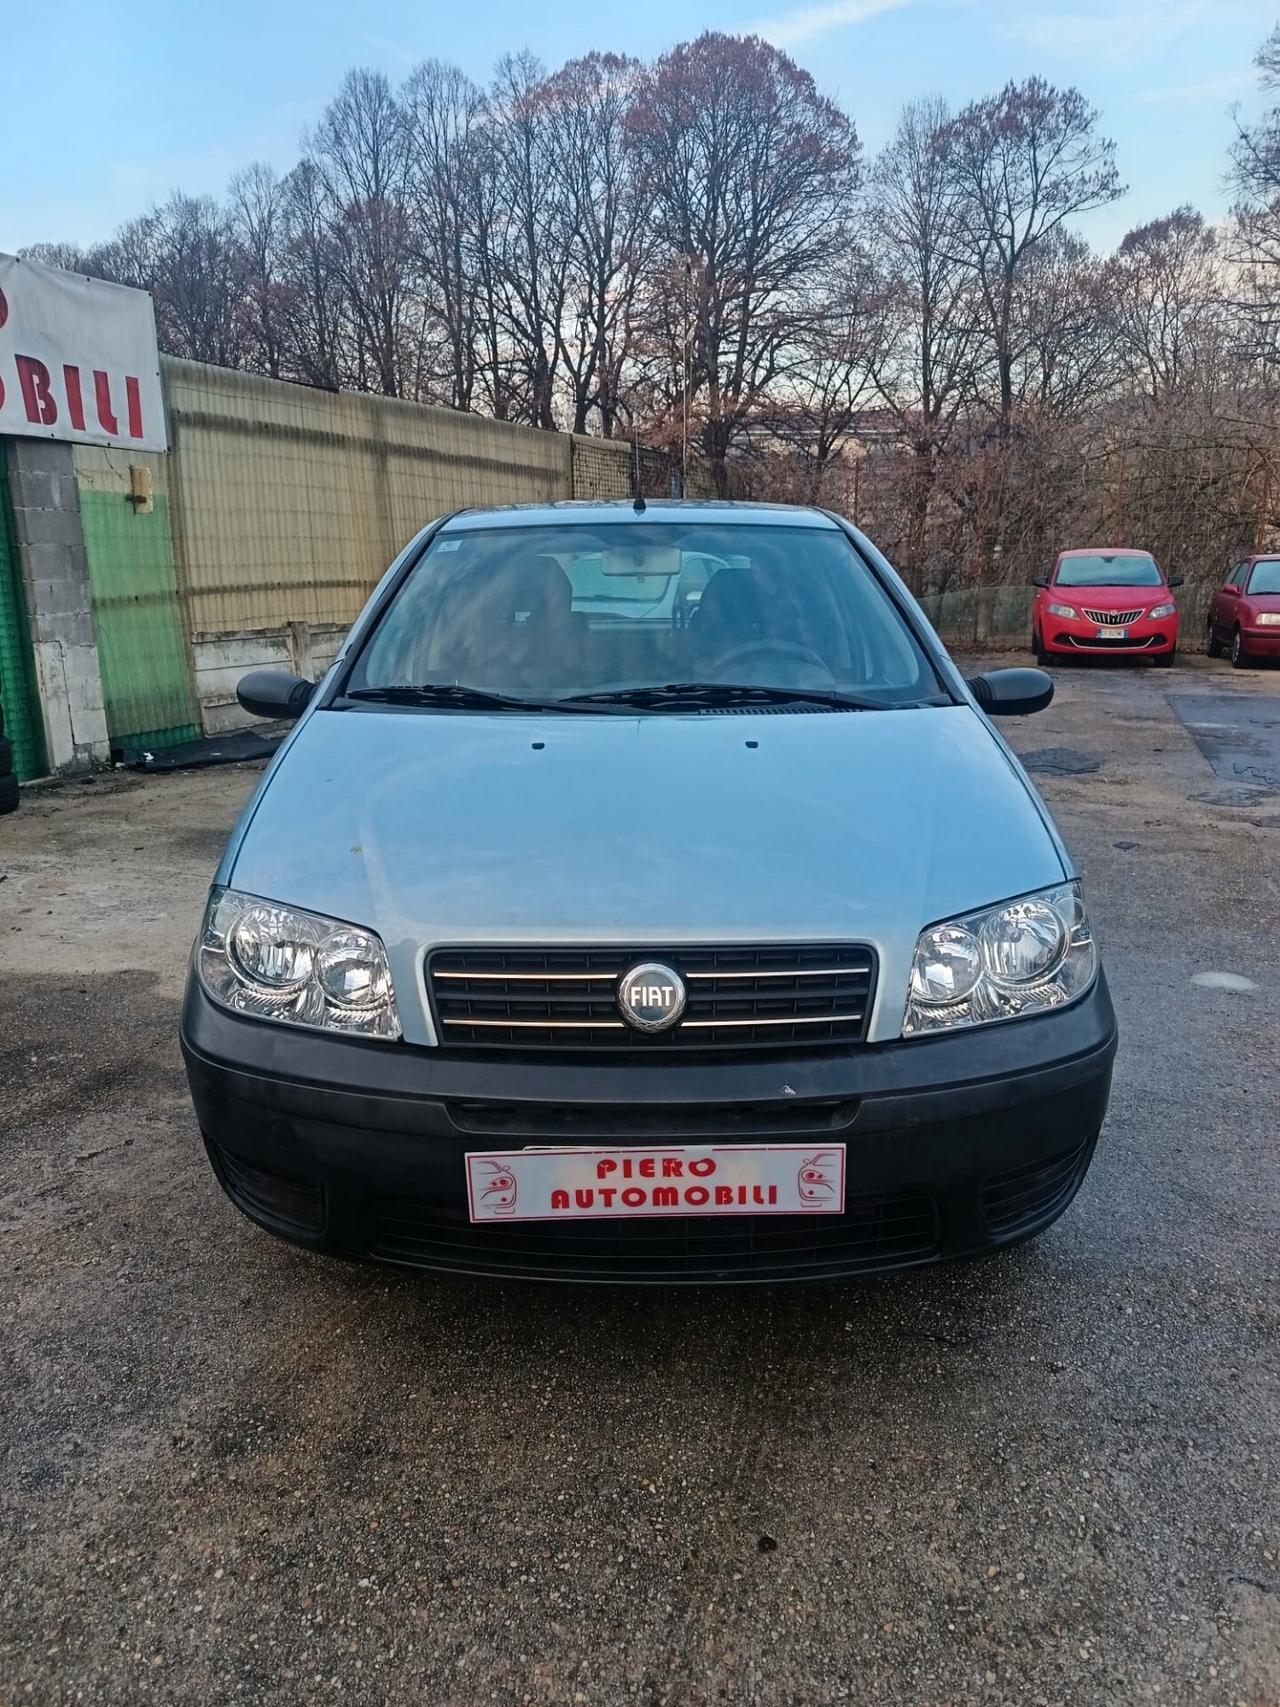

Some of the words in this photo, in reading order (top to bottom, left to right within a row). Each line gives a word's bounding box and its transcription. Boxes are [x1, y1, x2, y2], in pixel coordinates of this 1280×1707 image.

[0, 354, 143, 438] BILI
[630, 986, 674, 1007] FIAT
[597, 1157, 717, 1180] PIERO
[550, 1185, 778, 1209] AUTOMOBILI
